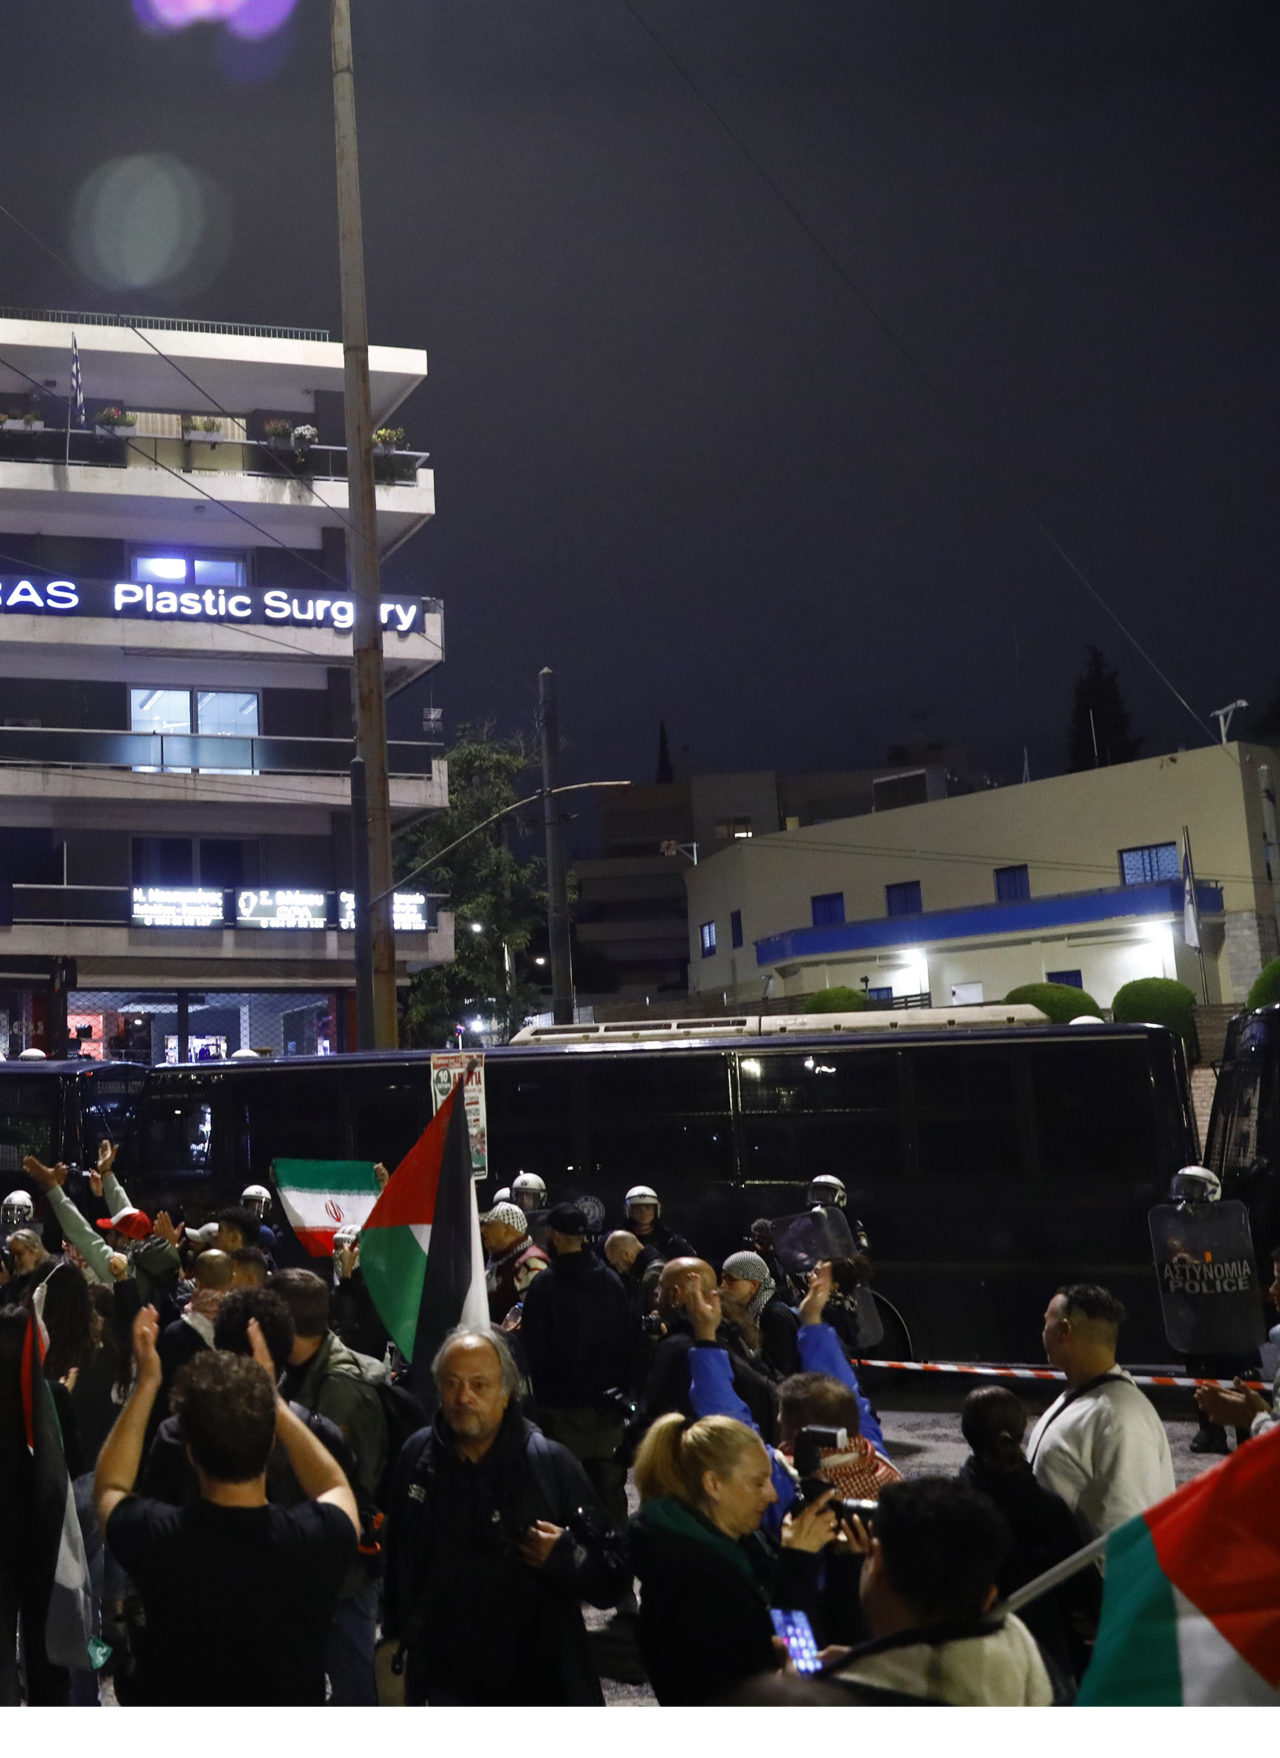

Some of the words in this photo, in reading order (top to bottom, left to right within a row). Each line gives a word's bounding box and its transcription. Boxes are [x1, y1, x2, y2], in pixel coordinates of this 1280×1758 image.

[114, 583, 252, 617] Plastic
[264, 590, 417, 631] Surgry
[438, 1069, 448, 1082] 10
[1164, 1260, 1251, 1280] ΑΣΤΥΝΟΜΙΑ
[1169, 1278, 1251, 1293] POLICE
